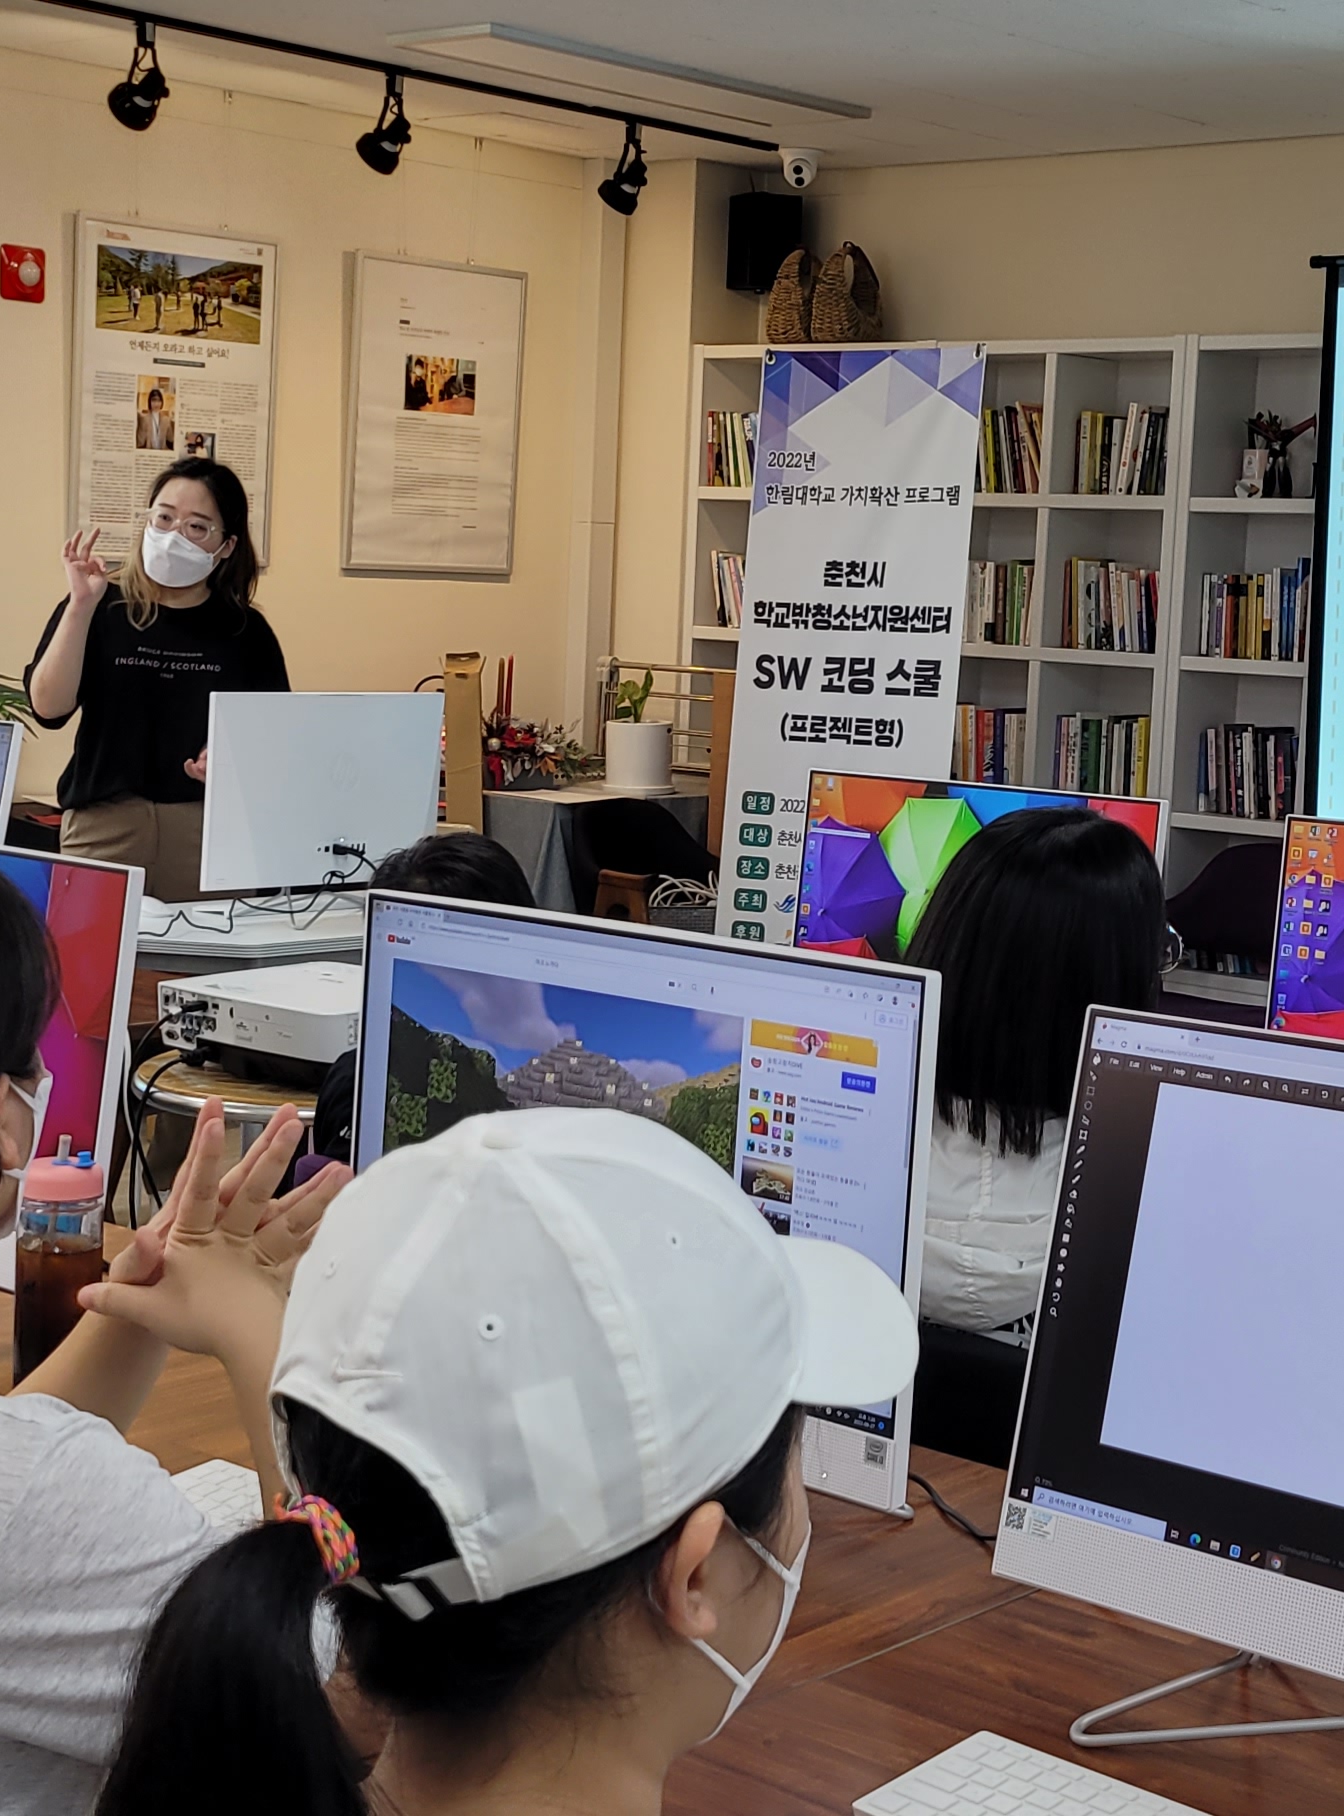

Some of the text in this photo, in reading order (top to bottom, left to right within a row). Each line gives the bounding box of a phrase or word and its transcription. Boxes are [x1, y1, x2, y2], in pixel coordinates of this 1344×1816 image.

[767, 451, 816, 471] 2022년
[766, 485, 961, 507] 한림대학교 가치확산 프로그램
[824, 560, 887, 588] 춘천시
[753, 601, 952, 635] 학교밖청소년지원센터
[115, 657, 161, 668] ENGLAND
[170, 662, 222, 672] SCOTLAND
[753, 654, 942, 698] SW 코딩 스쿨
[780, 712, 904, 748] (프로젝트형)
[746, 795, 805, 813] 일정 2022
[743, 827, 769, 844] 대상
[740, 859, 798, 880] 장소 춘천
[738, 891, 763, 908] 주최
[735, 923, 762, 939] 후원
[1129, 1060, 1141, 1069] Edit
[1149, 1063, 1163, 1073] View
[1172, 1066, 1186, 1078] Help
[1048, 1495, 1077, 1510] 검색하려면
[1078, 1503, 1096, 1516] 여기에
